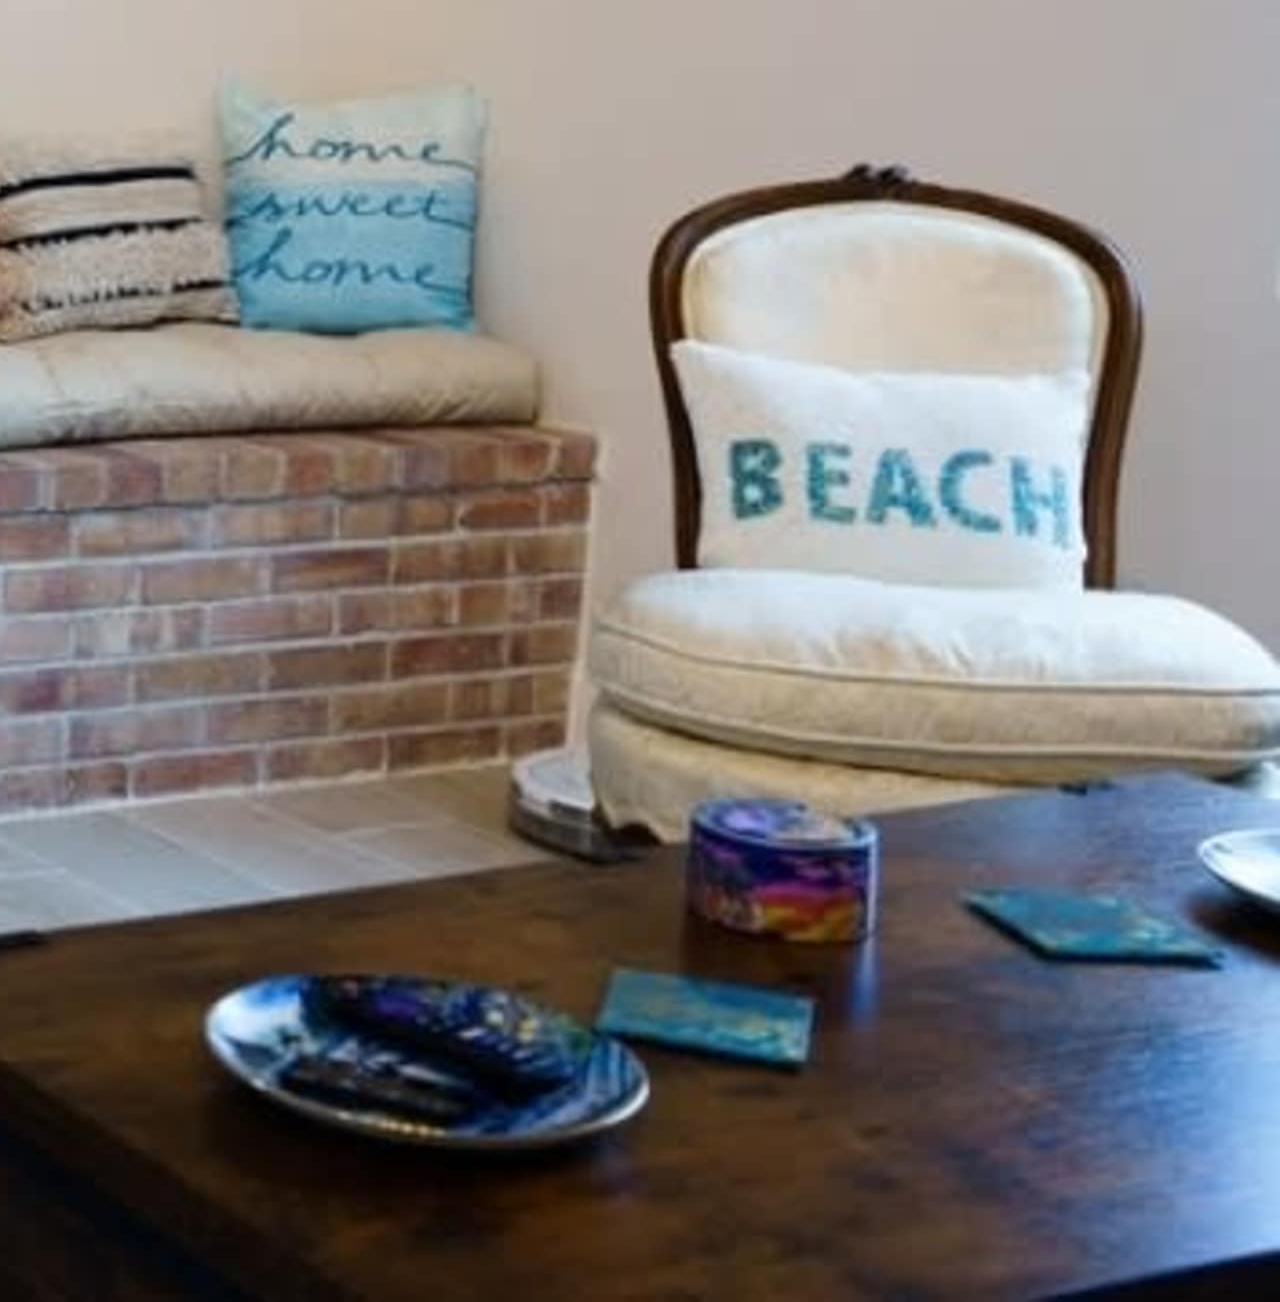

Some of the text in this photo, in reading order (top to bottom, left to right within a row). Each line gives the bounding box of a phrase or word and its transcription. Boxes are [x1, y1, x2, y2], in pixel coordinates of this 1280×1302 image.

[225, 111, 476, 172] home
[225, 190, 474, 232] sweet
[231, 227, 472, 296] home
[728, 437, 1071, 548] BEACH
